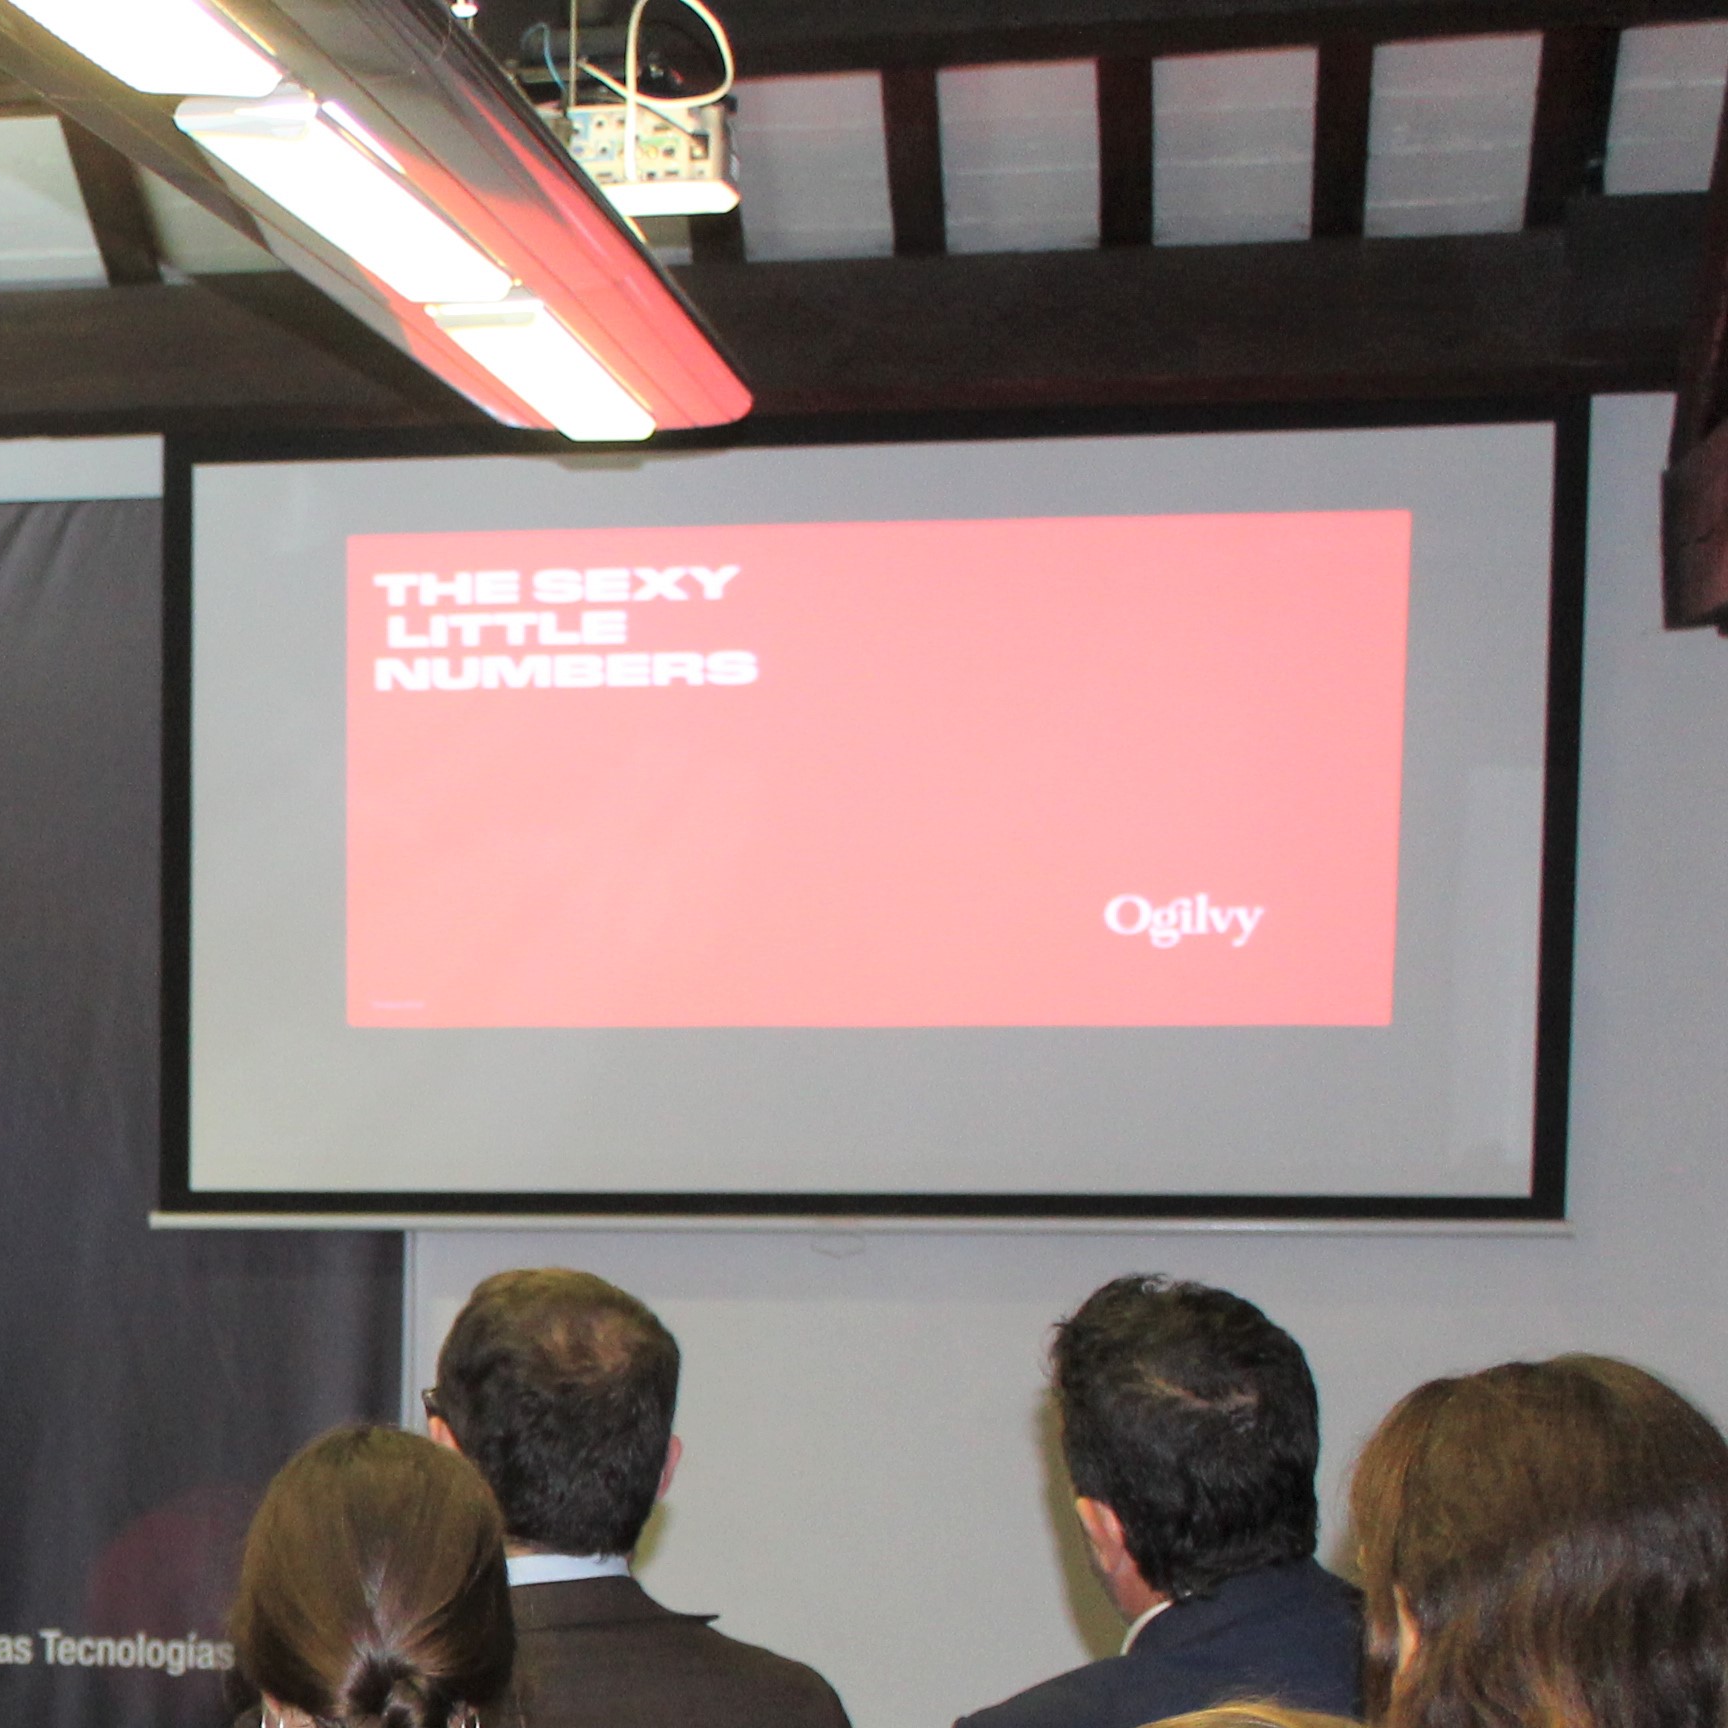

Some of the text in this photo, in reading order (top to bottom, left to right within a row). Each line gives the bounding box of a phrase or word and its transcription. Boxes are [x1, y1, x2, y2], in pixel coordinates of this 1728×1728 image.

[373, 564, 741, 606] THE SEXY
[387, 610, 628, 649] LITTLE
[373, 650, 760, 692] NUMBERS
[1103, 892, 1266, 949] Ogilvy
[39, 1627, 236, 1677] Tecnologías
